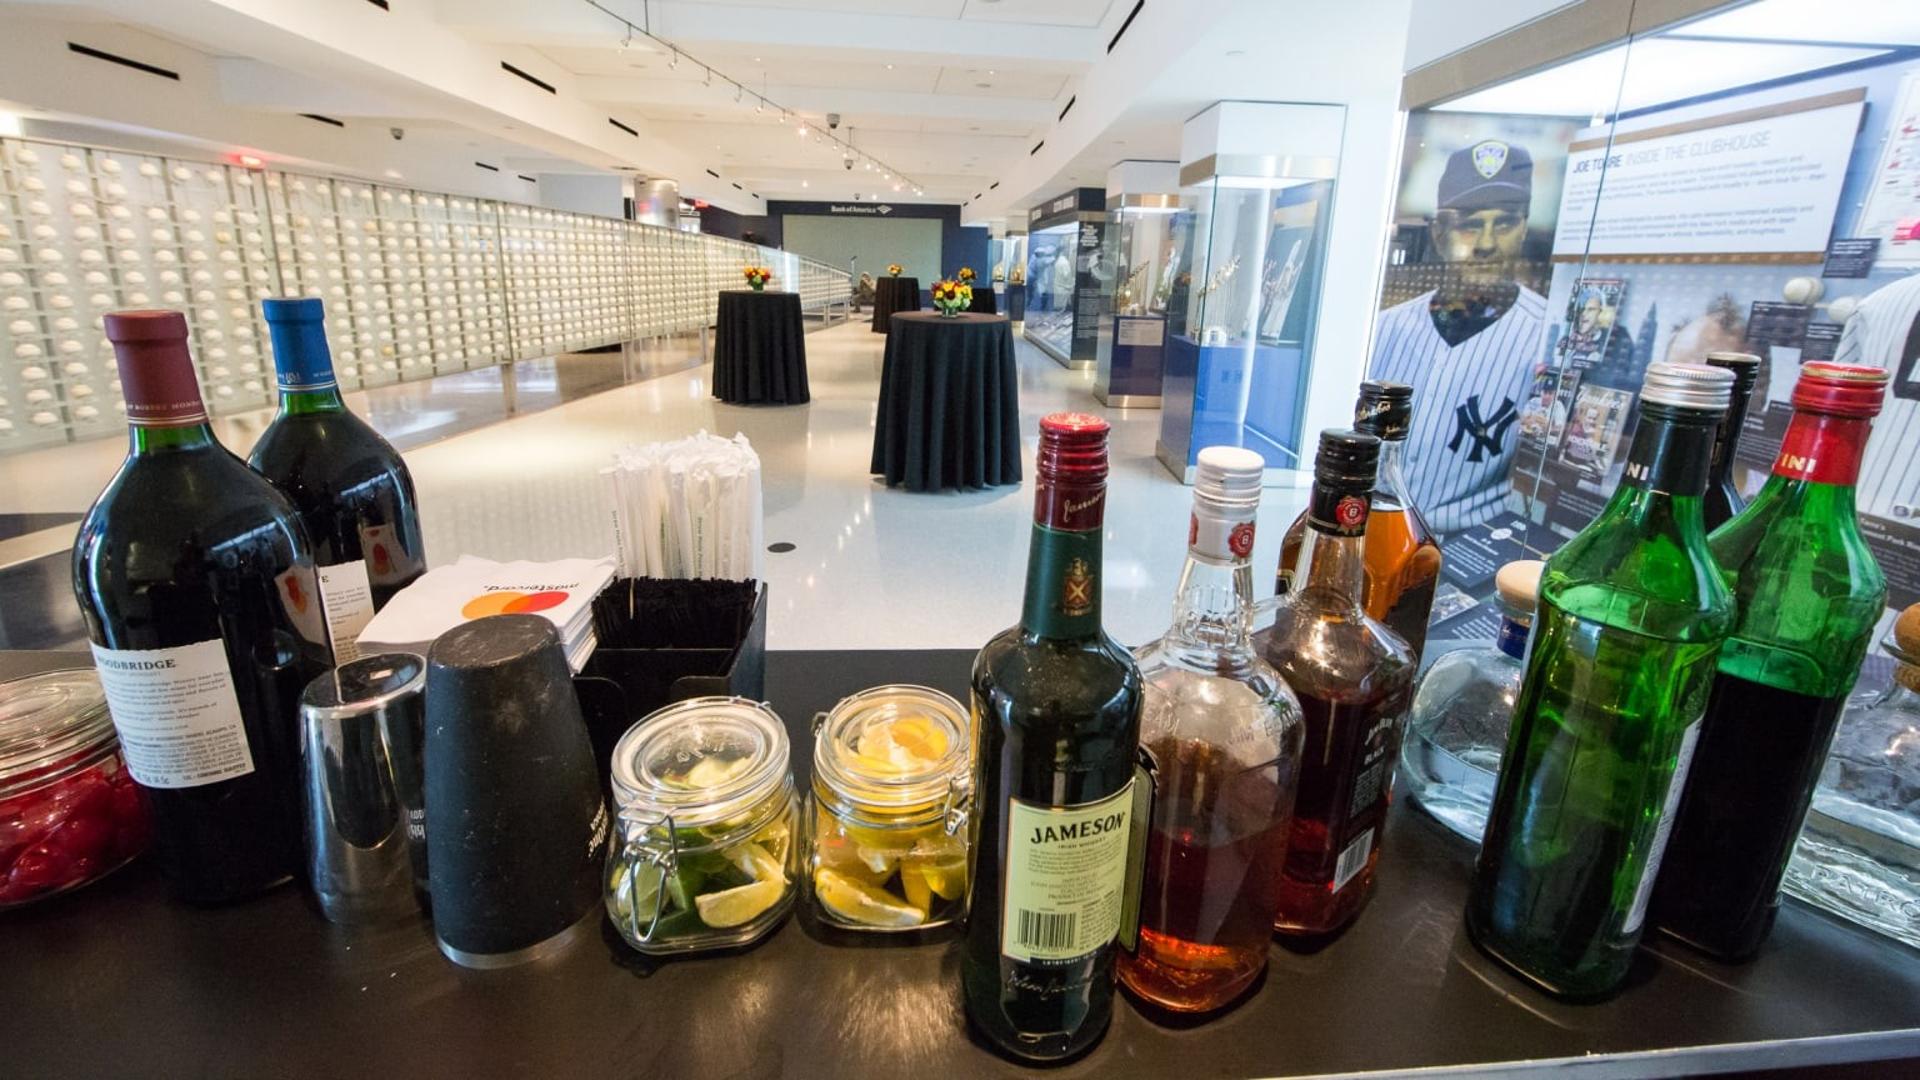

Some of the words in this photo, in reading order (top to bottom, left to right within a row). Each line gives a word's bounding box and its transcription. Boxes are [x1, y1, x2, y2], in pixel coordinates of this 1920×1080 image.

[1573, 160, 1589, 174] JOE
[1592, 155, 1623, 172] TORE
[1626, 149, 1660, 166] INSIDE
[1664, 144, 1687, 160] THE
[1689, 130, 1771, 157] CLUBHOUSE
[1030, 811, 1125, 845] JAMESON
